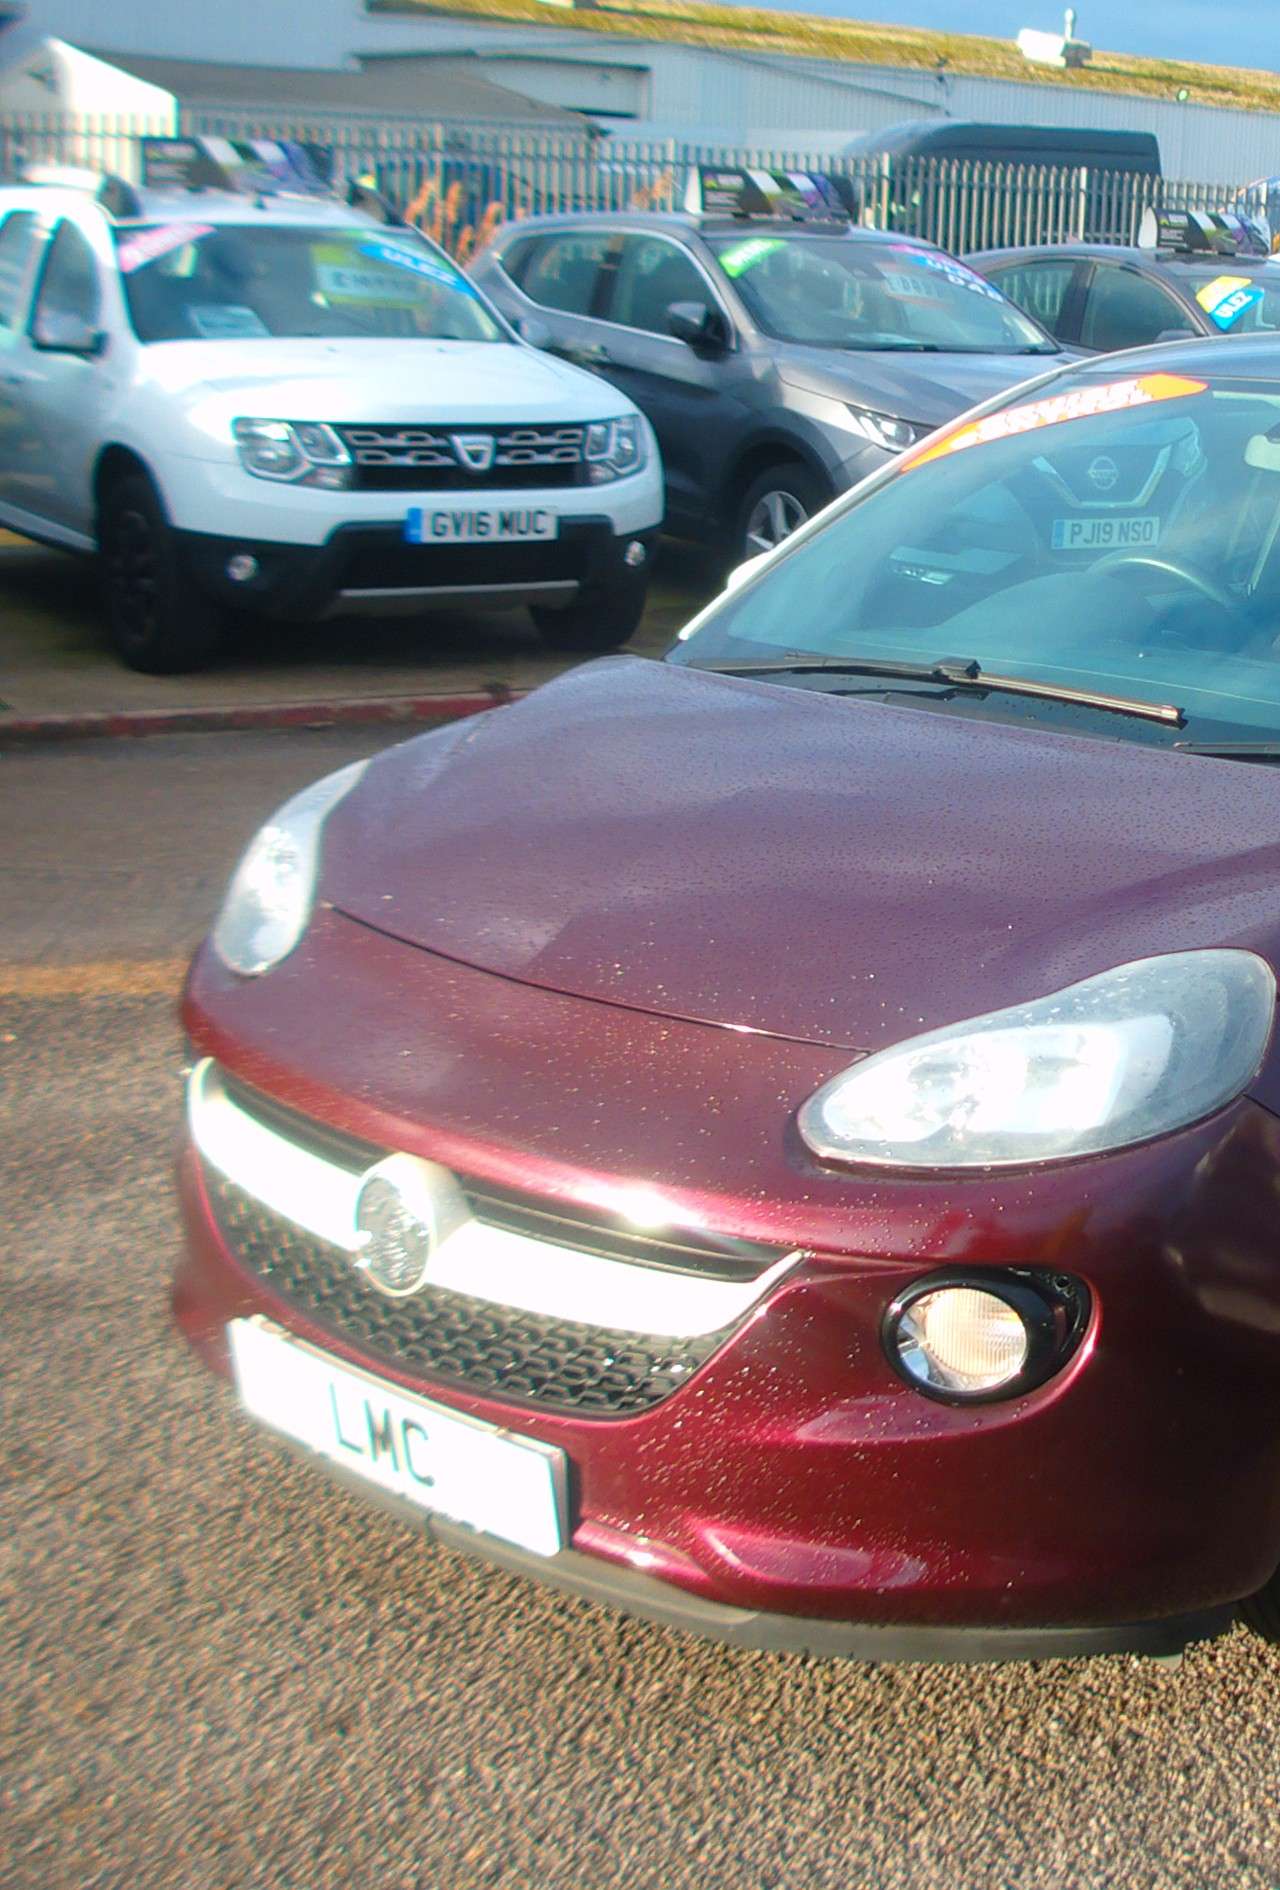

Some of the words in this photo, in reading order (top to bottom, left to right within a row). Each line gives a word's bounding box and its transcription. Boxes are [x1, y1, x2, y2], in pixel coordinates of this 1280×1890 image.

[431, 511, 492, 537] GV16
[498, 510, 548, 536] MUC
[1070, 522, 1113, 545] PJ19
[328, 1381, 435, 1488] LMC
